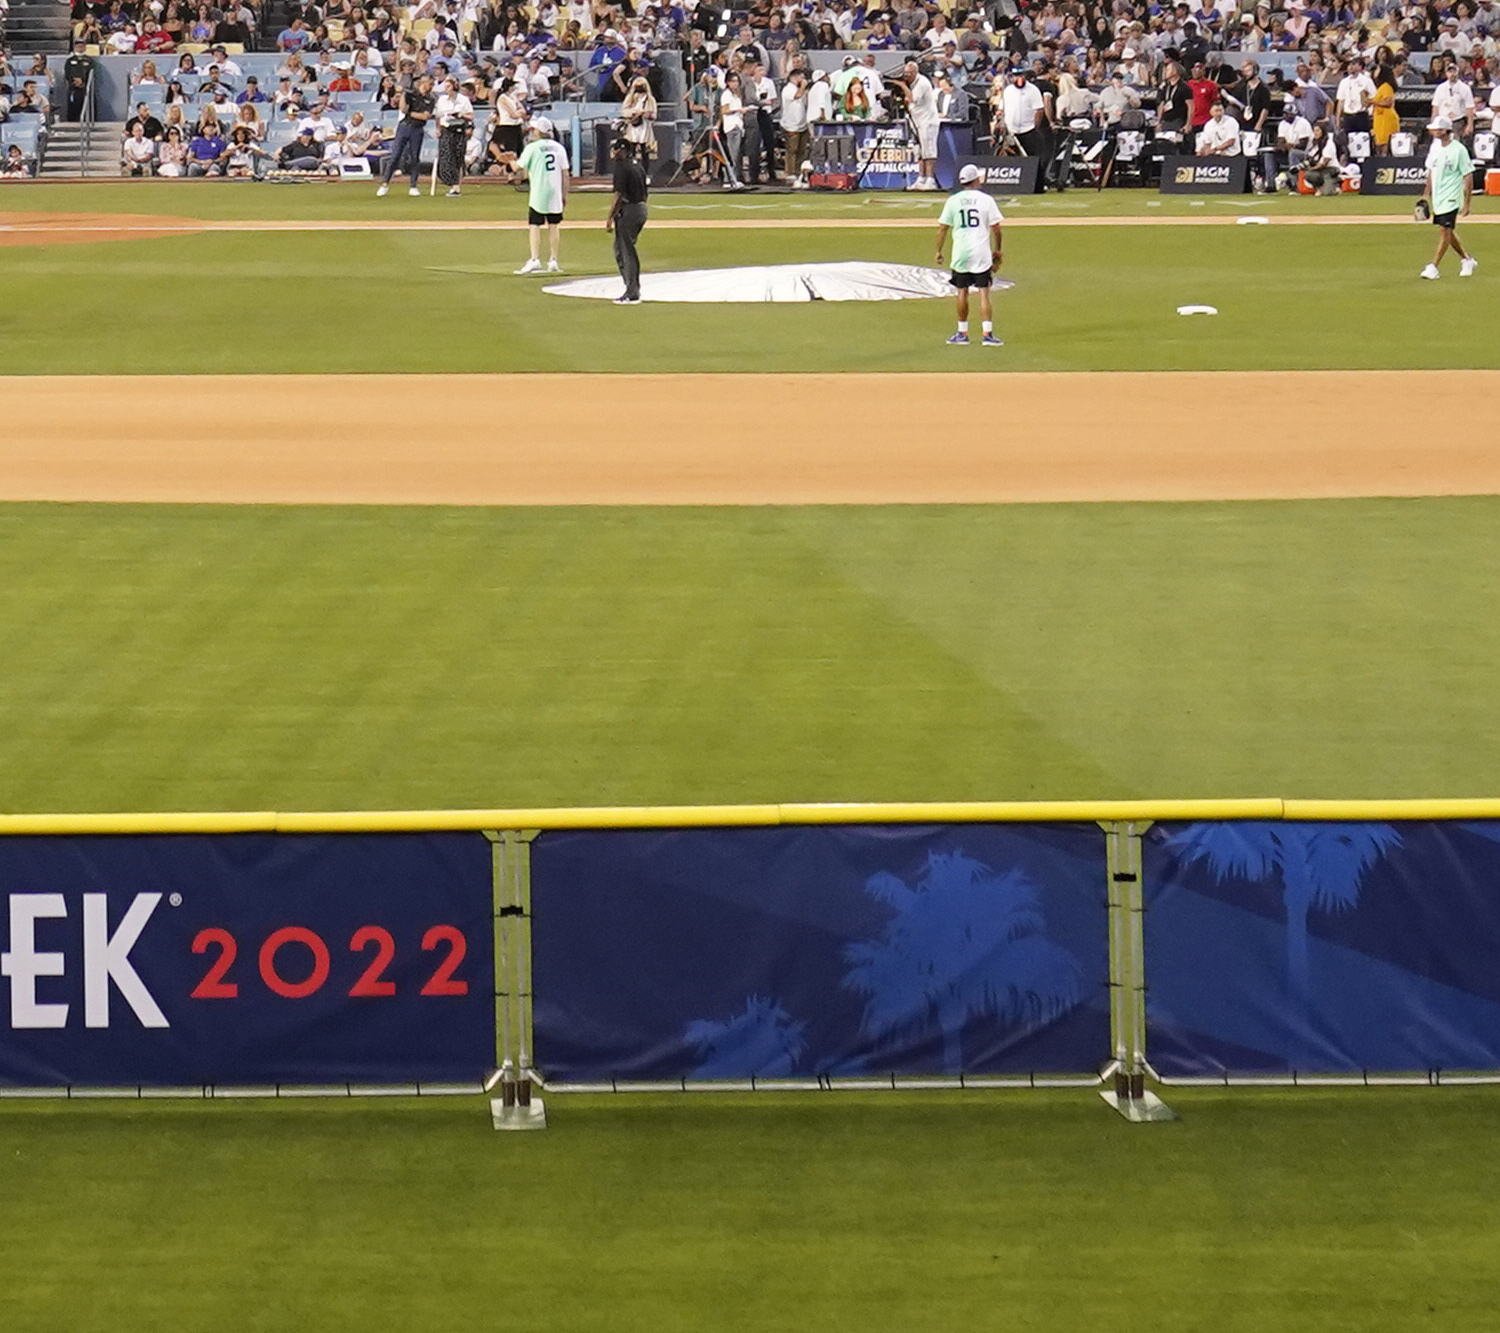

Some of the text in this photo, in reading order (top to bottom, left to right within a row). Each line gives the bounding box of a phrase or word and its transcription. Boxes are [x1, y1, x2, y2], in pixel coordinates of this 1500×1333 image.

[545, 153, 555, 171] 2
[987, 167, 1021, 178] MGM
[1194, 166, 1229, 178] MGM
[1394, 168, 1428, 178] MGM
[958, 209, 980, 228] 16
[190, 925, 469, 1000] 2022
